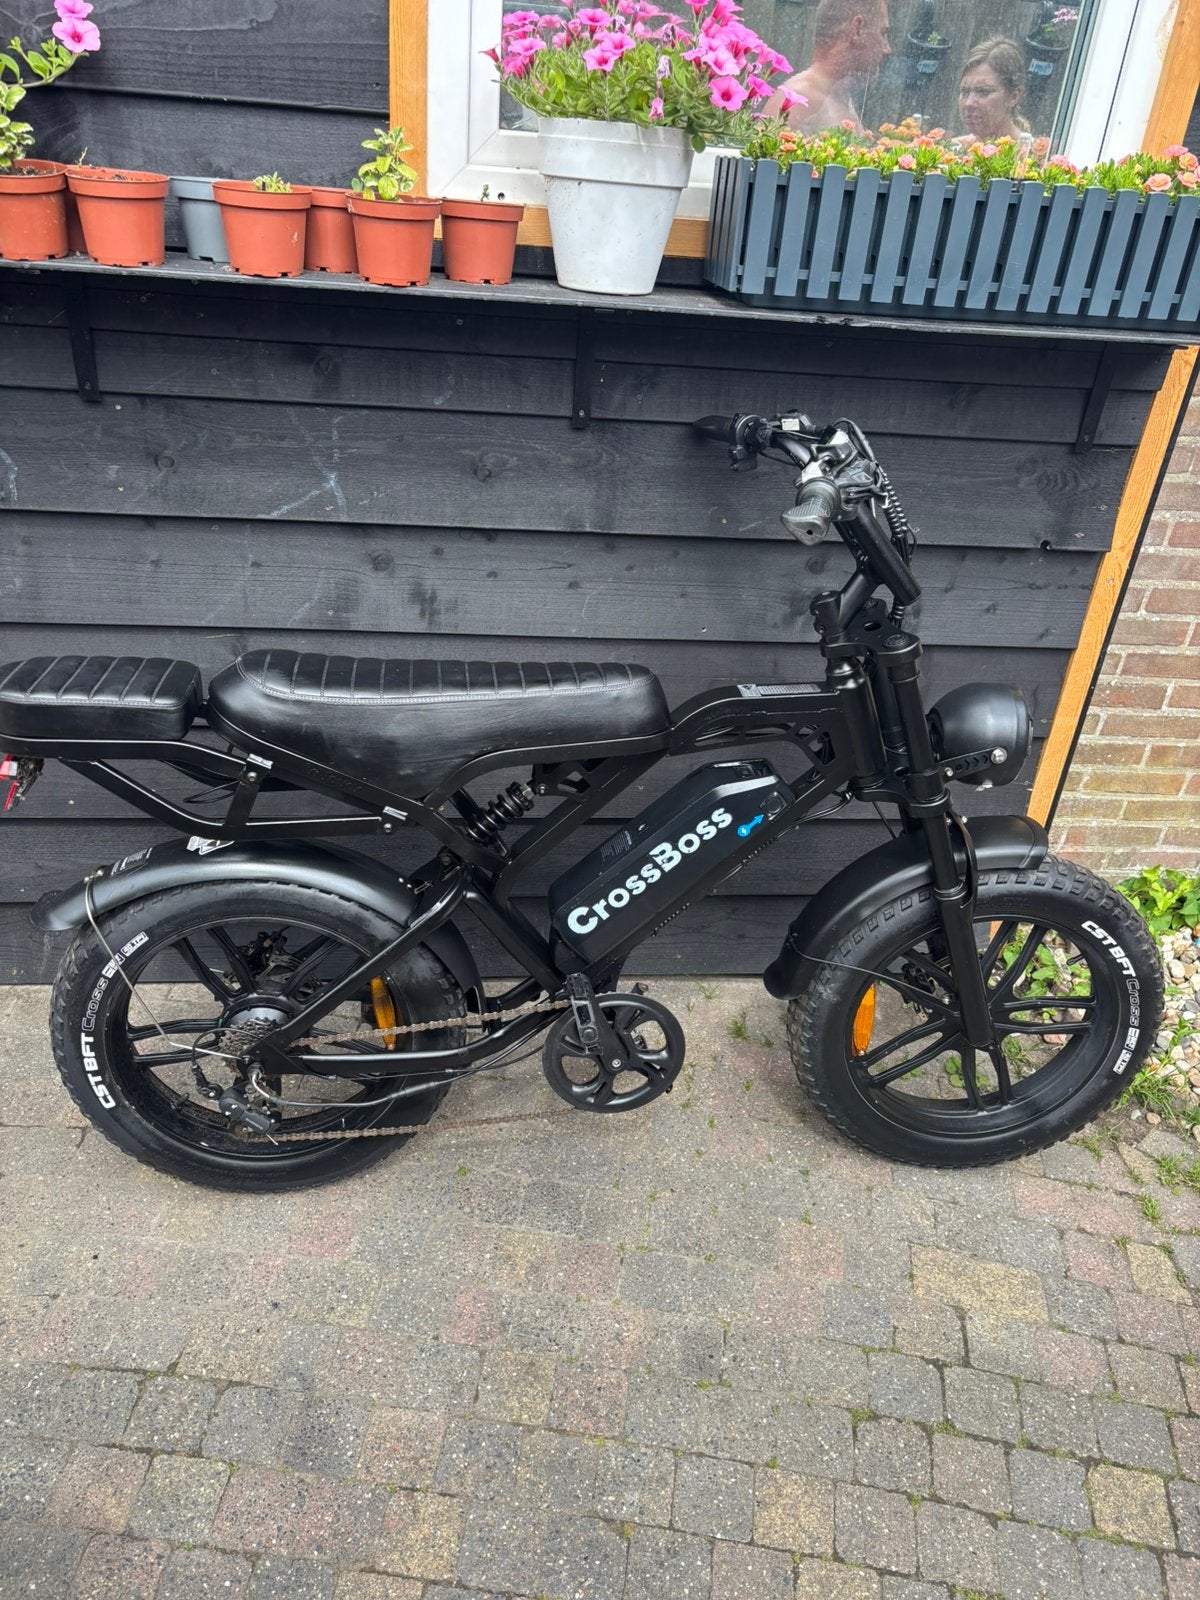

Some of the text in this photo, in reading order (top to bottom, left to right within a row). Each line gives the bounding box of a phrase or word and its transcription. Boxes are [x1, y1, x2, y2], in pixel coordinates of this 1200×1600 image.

[567, 807, 733, 934] CrossBoss
[1081, 920, 1117, 947] CST
[1108, 944, 1136, 978] BFT
[1126, 978, 1140, 1027] Cross
[81, 977, 116, 1109] CST BFT Cross
